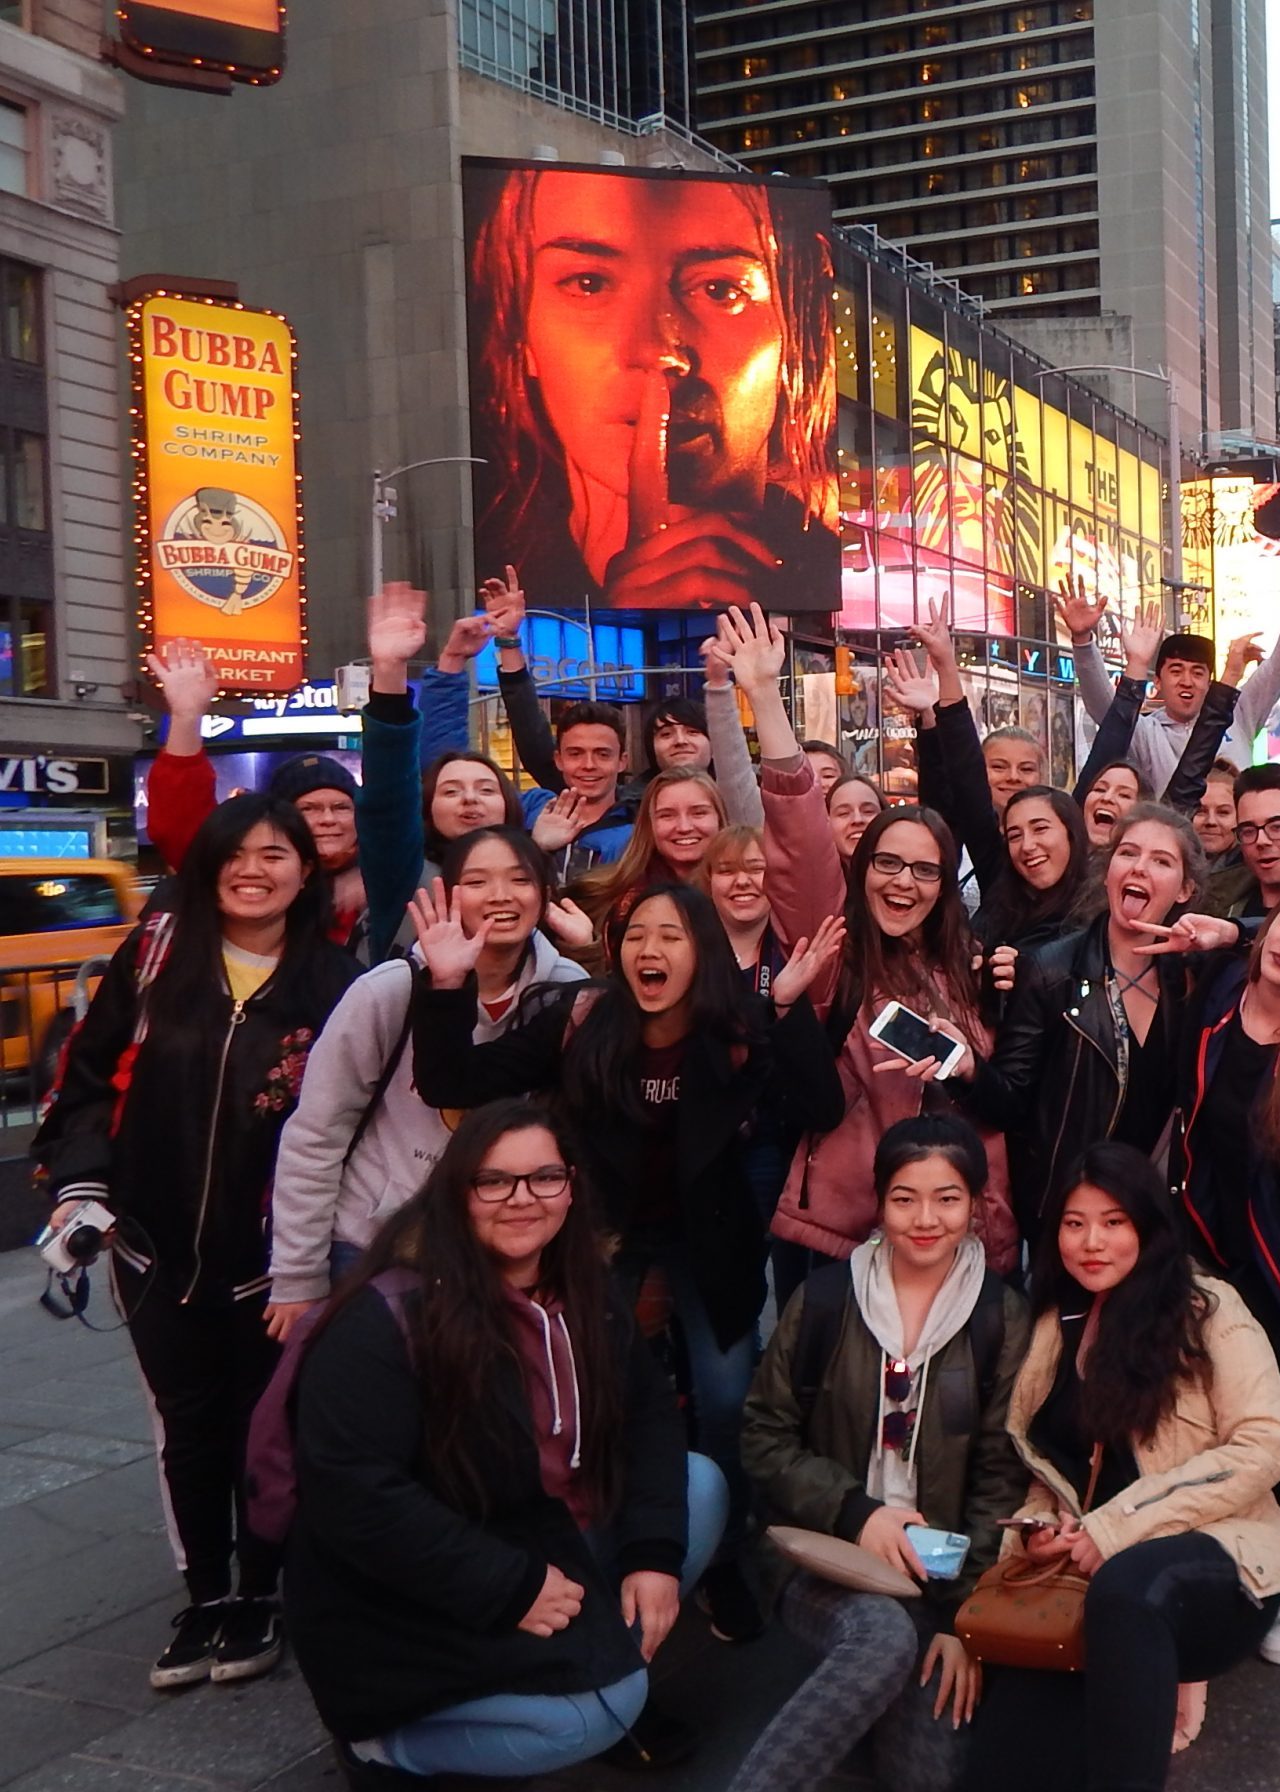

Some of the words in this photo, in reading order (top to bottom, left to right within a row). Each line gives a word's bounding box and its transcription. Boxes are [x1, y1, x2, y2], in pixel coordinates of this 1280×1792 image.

[151, 315, 284, 375] BUBBA
[164, 369, 275, 420] GUMP
[175, 425, 268, 447] SHRIMP
[163, 442, 280, 466] COMPANY
[1084, 461, 1118, 506] THE
[162, 544, 230, 566] BUBBA
[234, 545, 290, 573] GUMP
[186, 568, 233, 577] SHRIMP
[0, 755, 79, 794] VI'S
[760, 965, 770, 988] EOS
